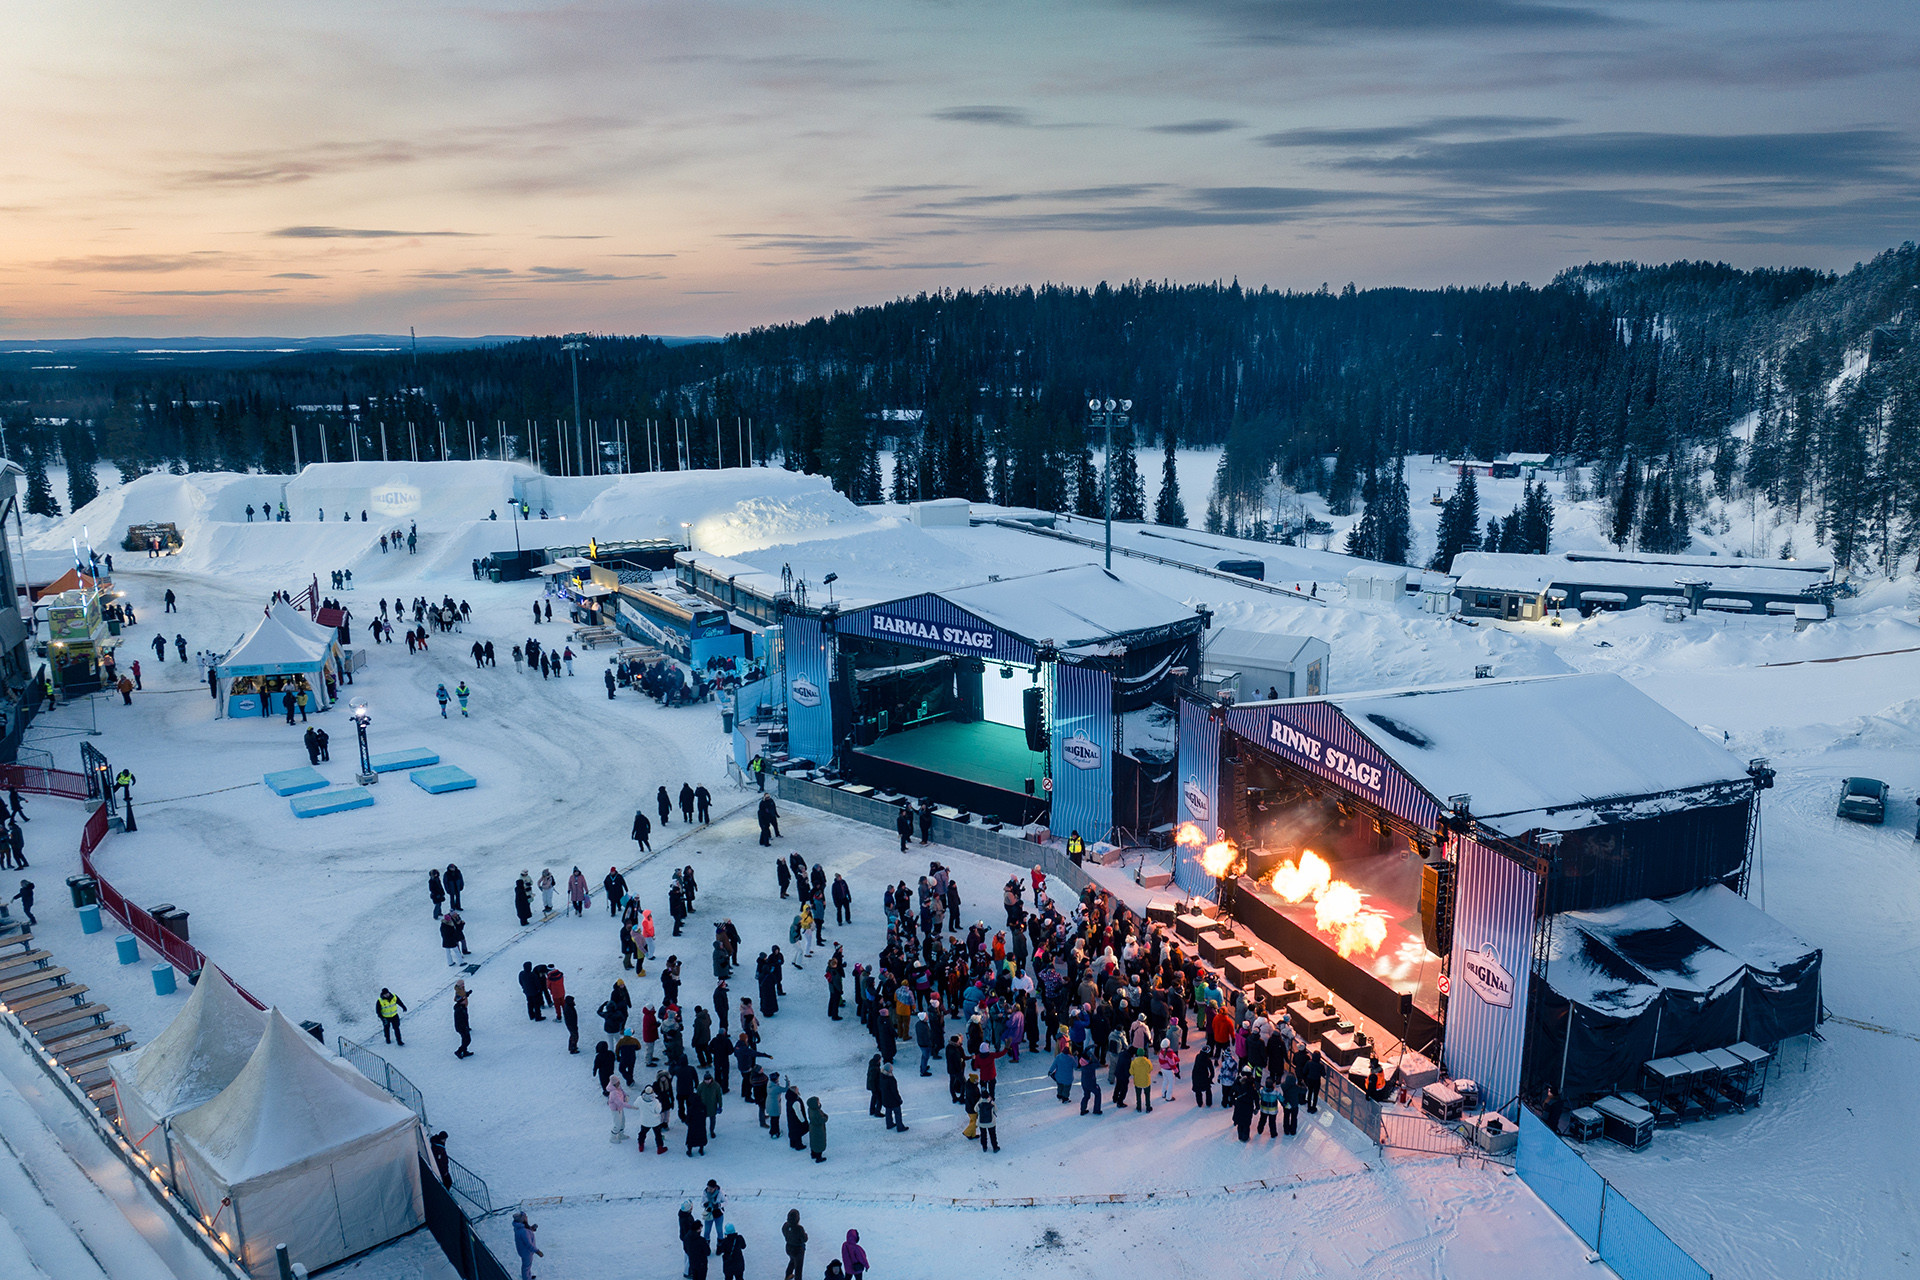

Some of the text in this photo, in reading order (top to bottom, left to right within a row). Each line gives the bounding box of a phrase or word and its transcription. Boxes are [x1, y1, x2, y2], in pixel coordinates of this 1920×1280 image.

[873, 615, 994, 649] HARMAA STAGE
[1064, 745, 1099, 759] ORIGINAL
[1270, 719, 1382, 791] RINNE STAGE
[1466, 961, 1511, 994] ORIGINAL
